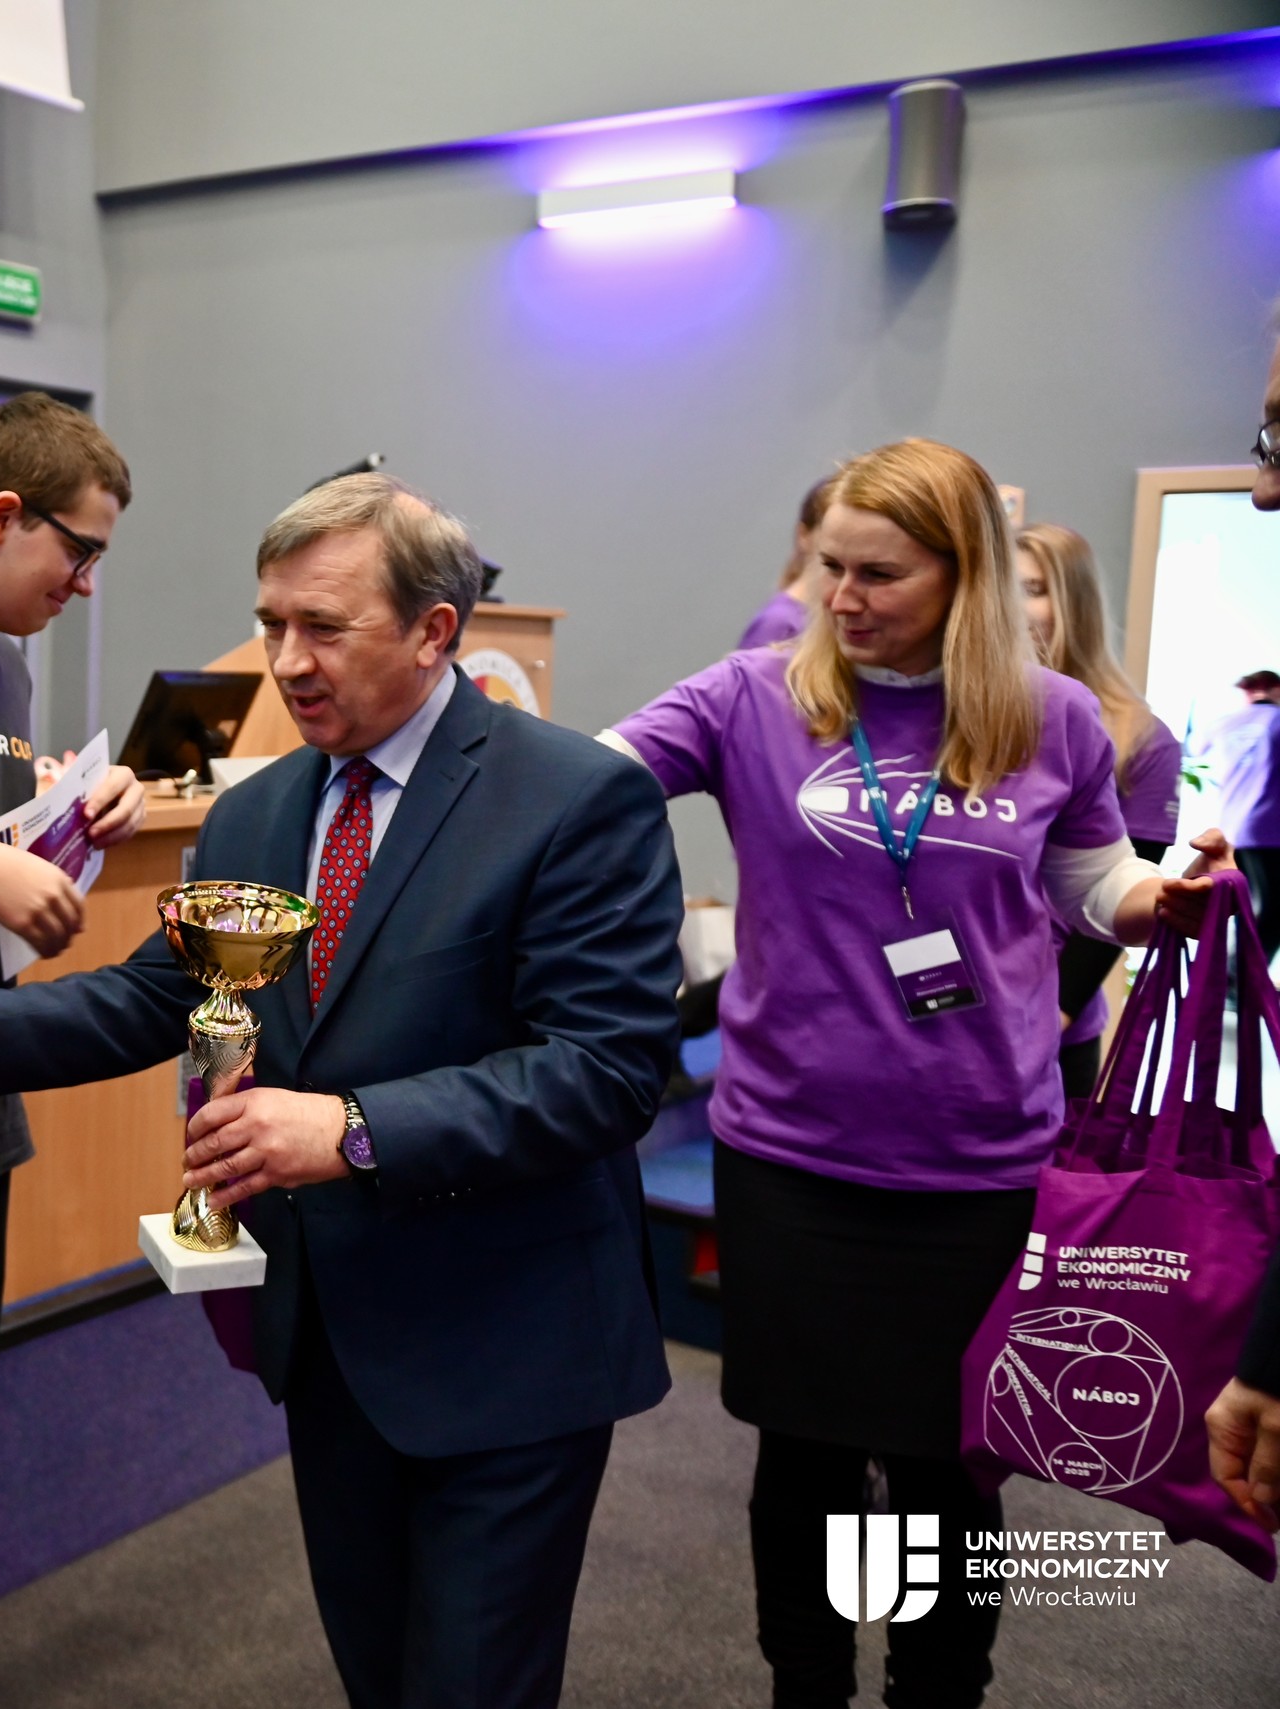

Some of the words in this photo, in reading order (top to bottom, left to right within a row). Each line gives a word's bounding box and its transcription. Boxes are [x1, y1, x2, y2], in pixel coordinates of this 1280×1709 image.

[1059, 1246, 1189, 1265] UNIWERSYTET
[1057, 1261, 1192, 1282] EKONOMICZNY
[1057, 1278, 1080, 1289] we
[1084, 1277, 1169, 1294] Wrocławiu
[1016, 1333, 1091, 1351] INTERNATIONAL
[1072, 1386, 1140, 1406] NÁBOJ
[1053, 1458, 1064, 1466] 14
[1067, 1460, 1103, 1470] MARCH
